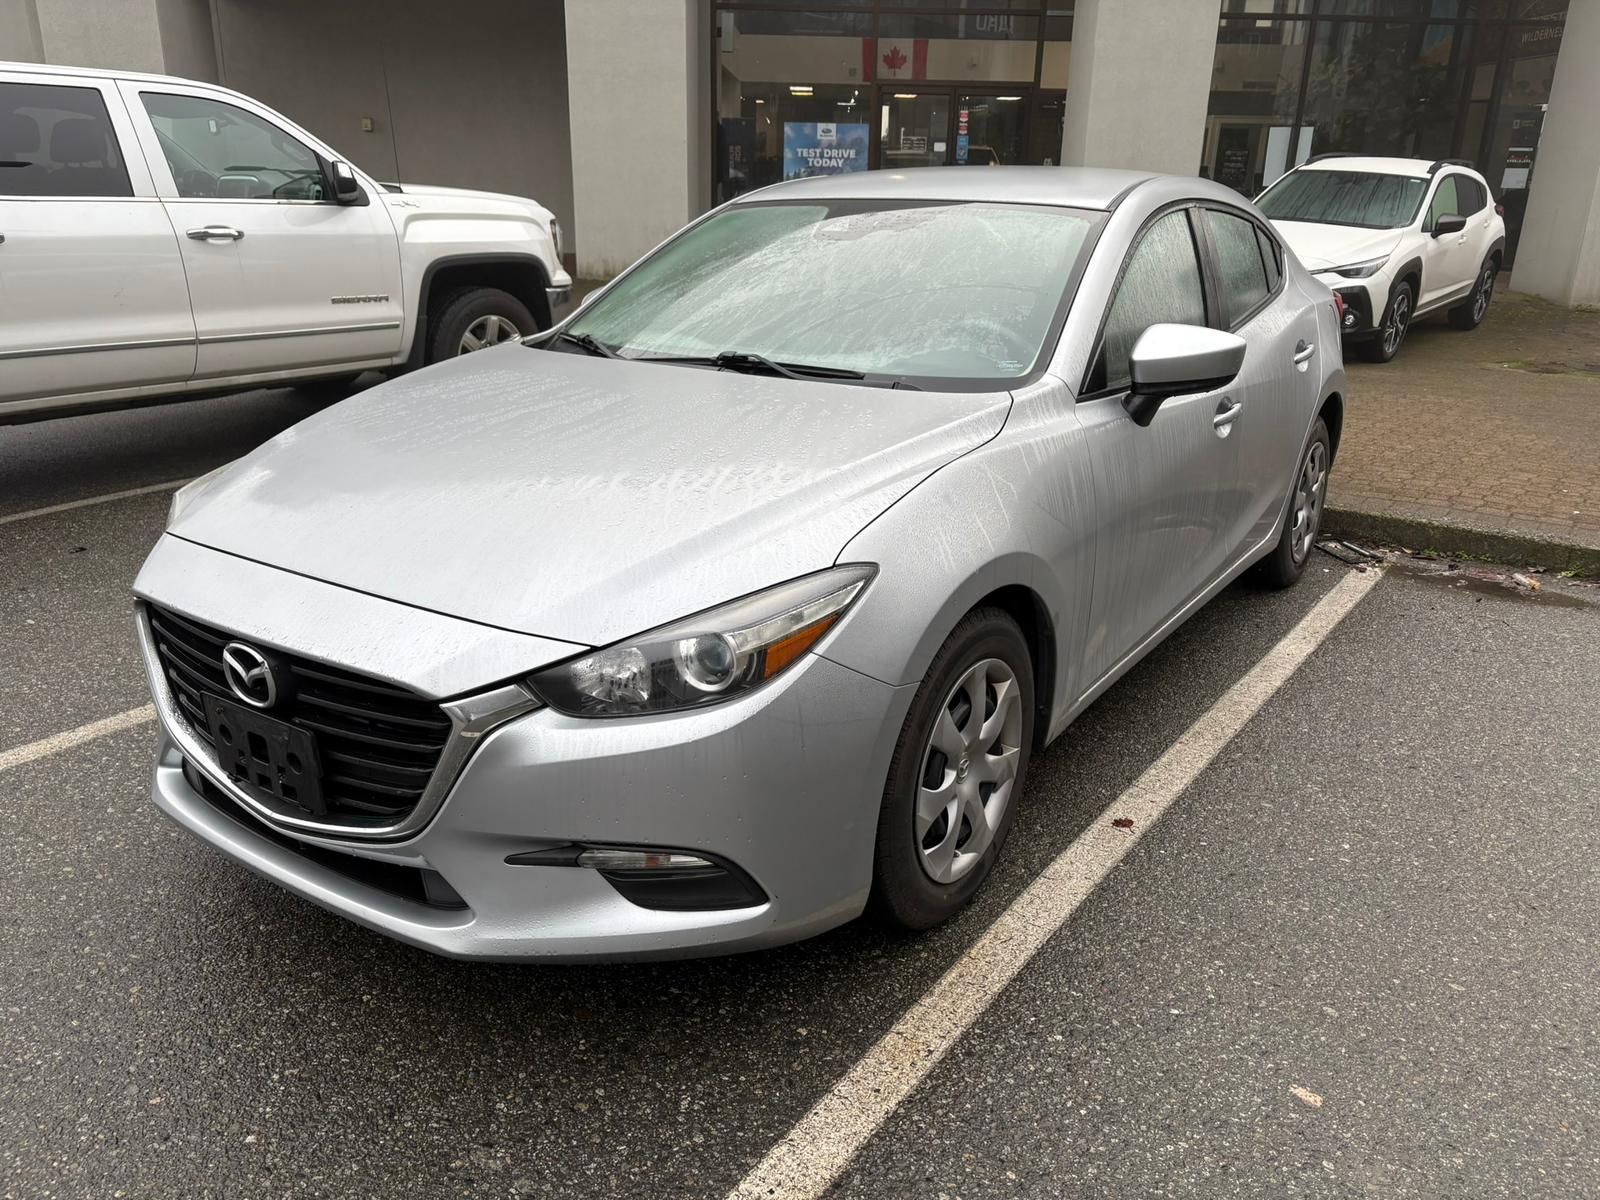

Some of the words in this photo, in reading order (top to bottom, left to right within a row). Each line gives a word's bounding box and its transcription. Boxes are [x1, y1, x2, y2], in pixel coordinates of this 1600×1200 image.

[796, 147, 822, 158] TEST
[823, 148, 857, 158] DRIVE
[807, 157, 844, 168] TODAY
[331, 295, 389, 304] SIERRA
